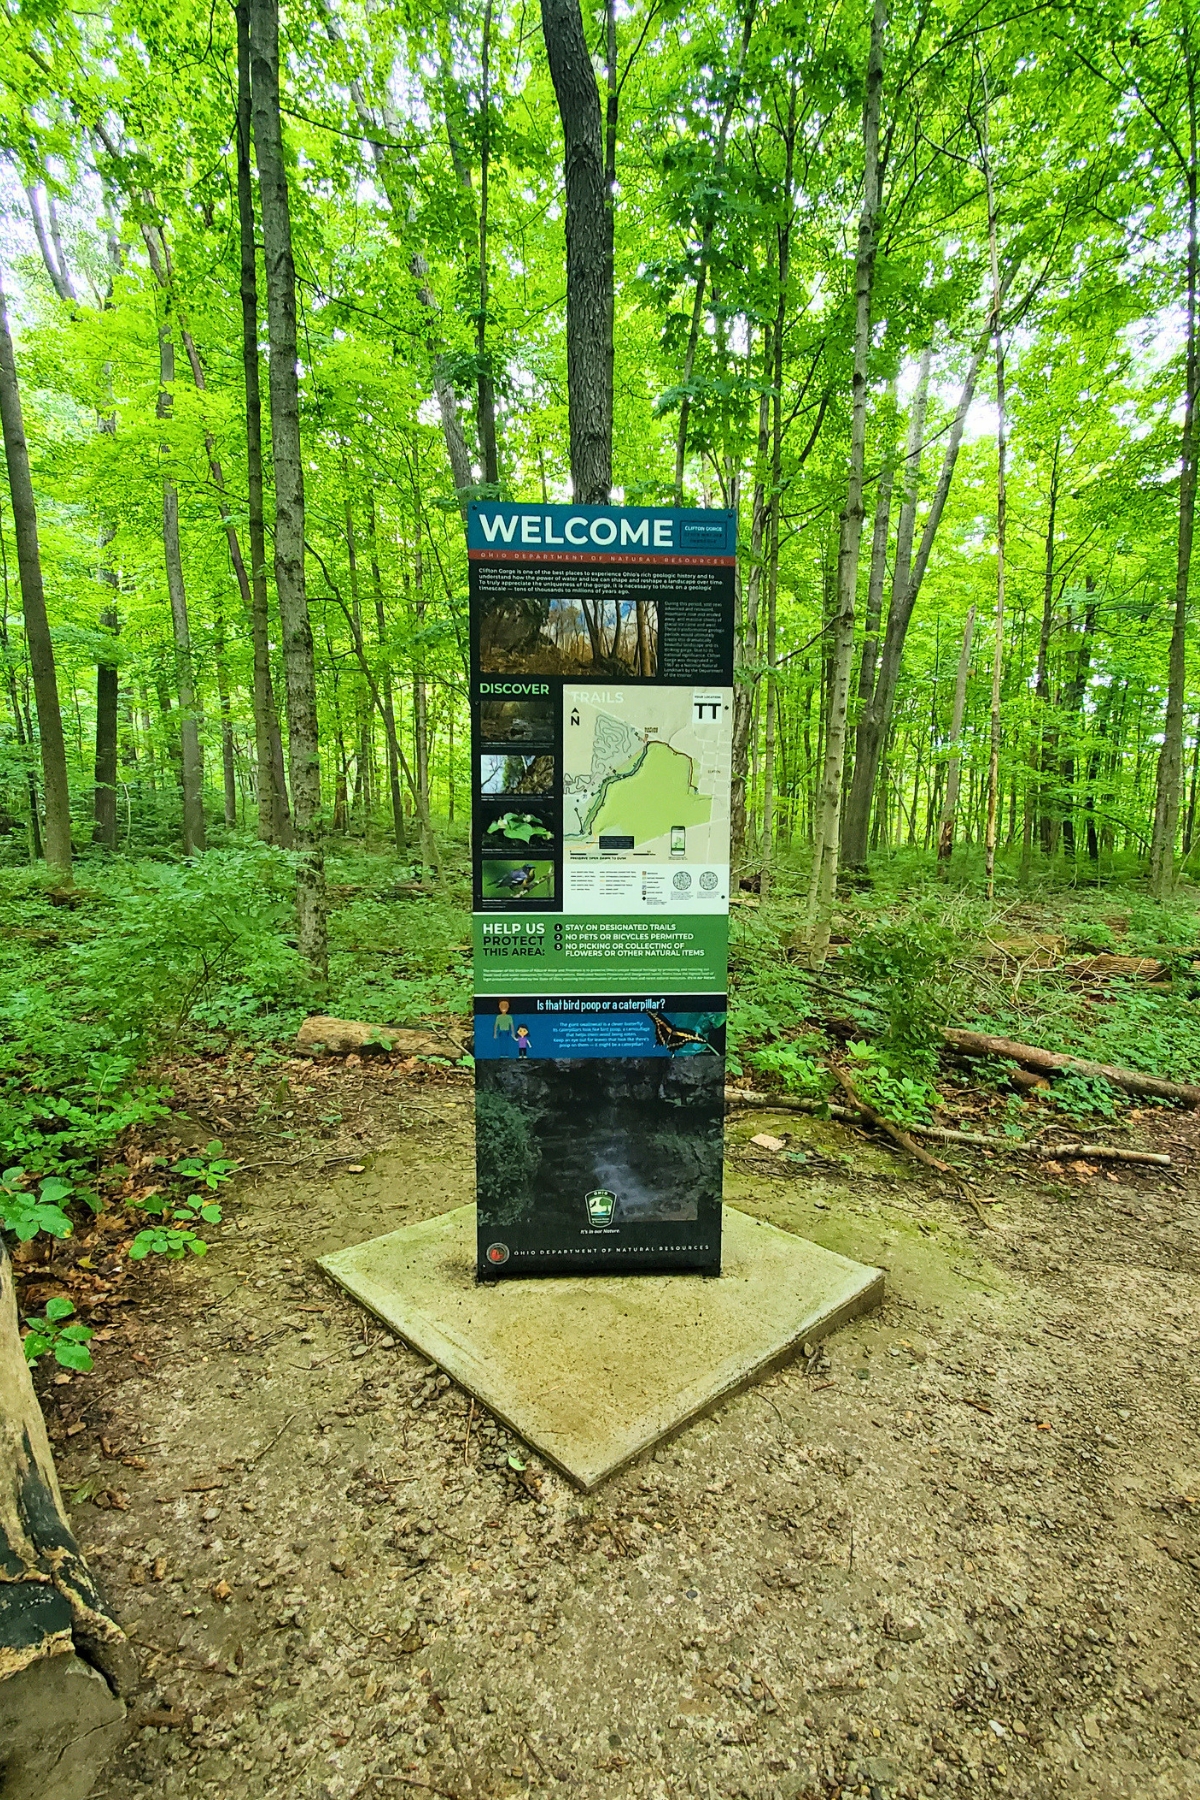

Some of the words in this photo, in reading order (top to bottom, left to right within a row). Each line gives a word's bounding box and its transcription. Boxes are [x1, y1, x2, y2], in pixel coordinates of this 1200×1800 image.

[478, 514, 673, 546] WELCOME
[480, 683, 549, 695] DISCOVER
[570, 691, 624, 703] TRAILS
[694, 703, 721, 719] TT
[570, 716, 580, 726] N
[483, 923, 521, 934] HELP
[526, 923, 545, 934] US
[483, 936, 544, 946] PROTECT
[483, 948, 508, 956] THIS
[512, 948, 545, 956] AREA:
[537, 1000, 544, 1010] Is
[545, 1000, 562, 1010] that
[563, 999, 579, 1010] bird
[581, 1002, 601, 1012] poop
[602, 1001, 611, 1010] or
[612, 1001, 617, 1010] a
[619, 998, 665, 1011] caterpillar?
